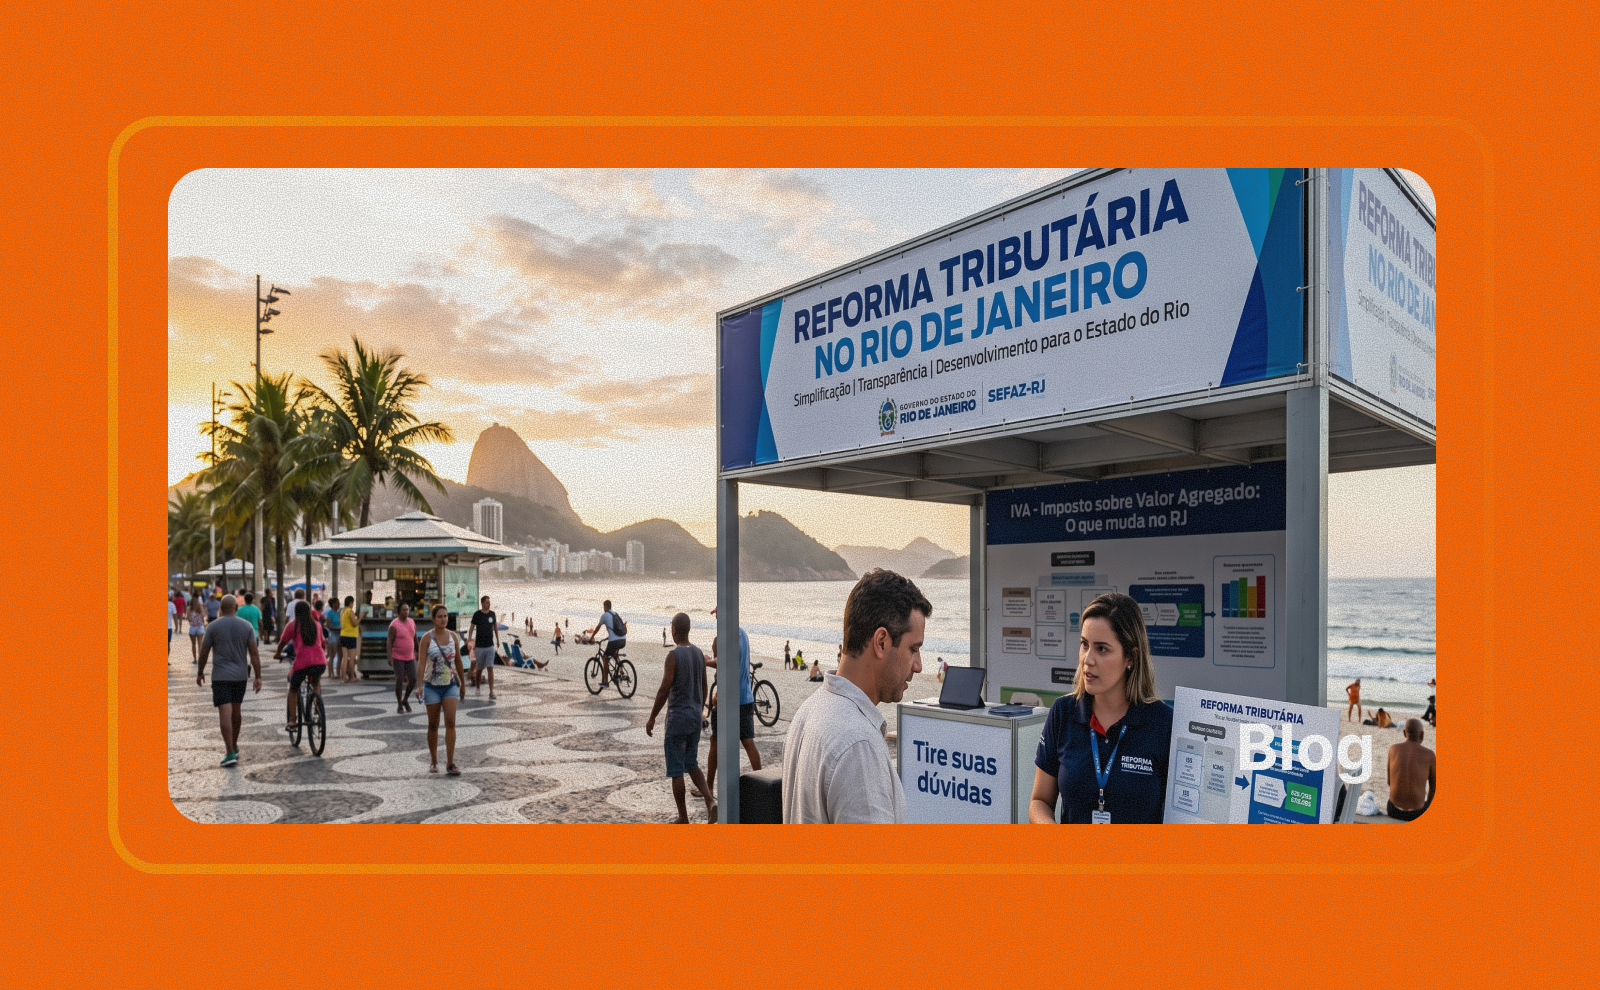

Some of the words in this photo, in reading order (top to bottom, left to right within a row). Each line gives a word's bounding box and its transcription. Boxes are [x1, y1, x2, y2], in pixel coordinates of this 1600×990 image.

[1358, 179, 1412, 270] REFORMA
[794, 267, 934, 344] REFORMA
[939, 178, 1190, 298] TRIBUTÁRIA
[1368, 243, 1386, 292] NO
[1387, 261, 1406, 309] RIO
[1407, 278, 1420, 321] DE
[815, 337, 855, 379] NO
[861, 320, 913, 367] RIO
[920, 303, 963, 352] DE
[971, 251, 1148, 339] JANEIRO
[793, 382, 851, 407] Simplificação
[858, 363, 928, 393] Transparência
[936, 338, 1038, 375] Desenvolvimento
[1041, 330, 1071, 354] para
[1073, 328, 1083, 342] o
[1086, 312, 1136, 340] Estado
[1140, 306, 1160, 327] do
[1164, 300, 1190, 321] Rio
[899, 399, 929, 411] GOVERNO
[929, 397, 939, 405] DO
[940, 391, 965, 404] ESTADO
[966, 389, 977, 398] DO
[987, 379, 1046, 403] SEFAZ-RJ
[899, 407, 917, 424] RIO
[918, 407, 932, 420] DE
[932, 399, 977, 418] JANEIRO
[1010, 503, 1031, 518] IVA
[1040, 499, 1093, 518] Imposto
[1095, 494, 1133, 511] sobre
[1135, 490, 1175, 508] Valor
[1177, 482, 1260, 507] Agregado:
[1065, 518, 1076, 533] O
[1078, 519, 1103, 535] que
[1105, 513, 1146, 531] muda
[1148, 514, 1167, 528] no
[1170, 509, 1188, 526] RJ
[1200, 698, 1244, 715] REFORMA
[1245, 705, 1304, 725] TRIBUTÁRIA
[912, 739, 948, 766] Tire
[951, 750, 998, 776] suas
[917, 771, 993, 807] dúvidas
